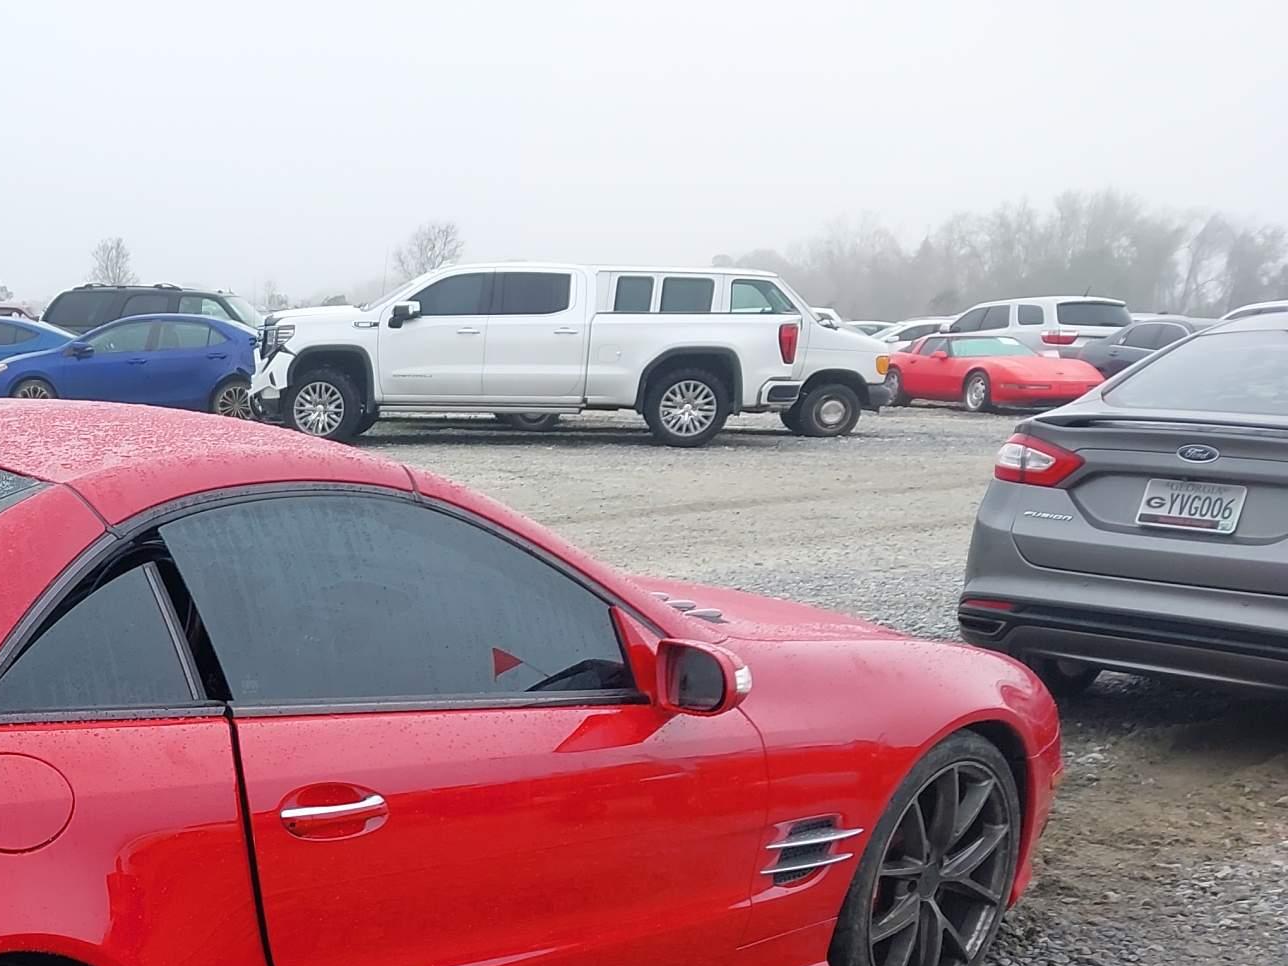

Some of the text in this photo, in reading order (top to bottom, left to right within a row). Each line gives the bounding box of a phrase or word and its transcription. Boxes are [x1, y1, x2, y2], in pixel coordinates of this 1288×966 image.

[1171, 482, 1223, 495] GEORGIA
[1168, 493, 1235, 520] YVG006
[1024, 511, 1073, 521] FUSION
